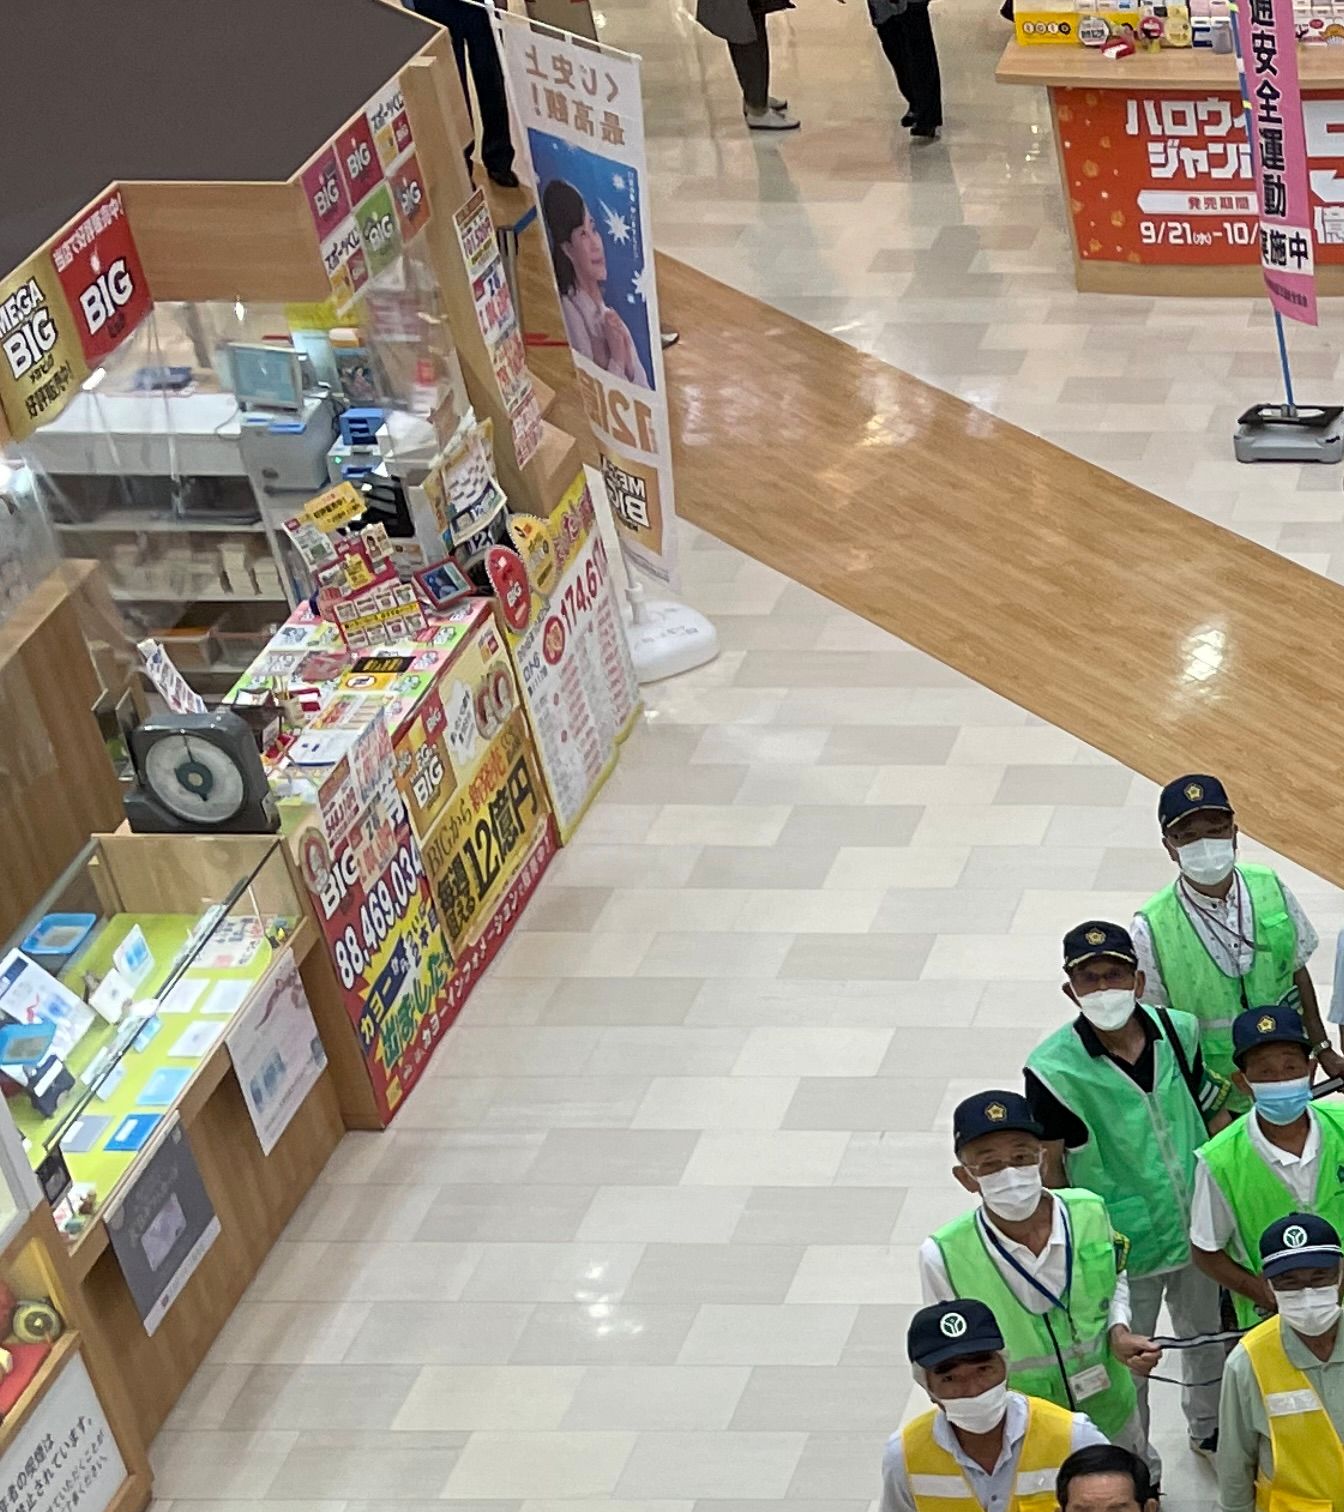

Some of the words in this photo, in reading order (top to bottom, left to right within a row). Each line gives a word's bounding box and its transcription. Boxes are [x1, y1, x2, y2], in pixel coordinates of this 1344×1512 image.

[1125, 98, 1249, 136] ハロウィ
[80, 257, 133, 335] BIG
[3, 307, 59, 381] BIG
[463, 755, 538, 902] 12億円
[319, 849, 358, 921] BIG
